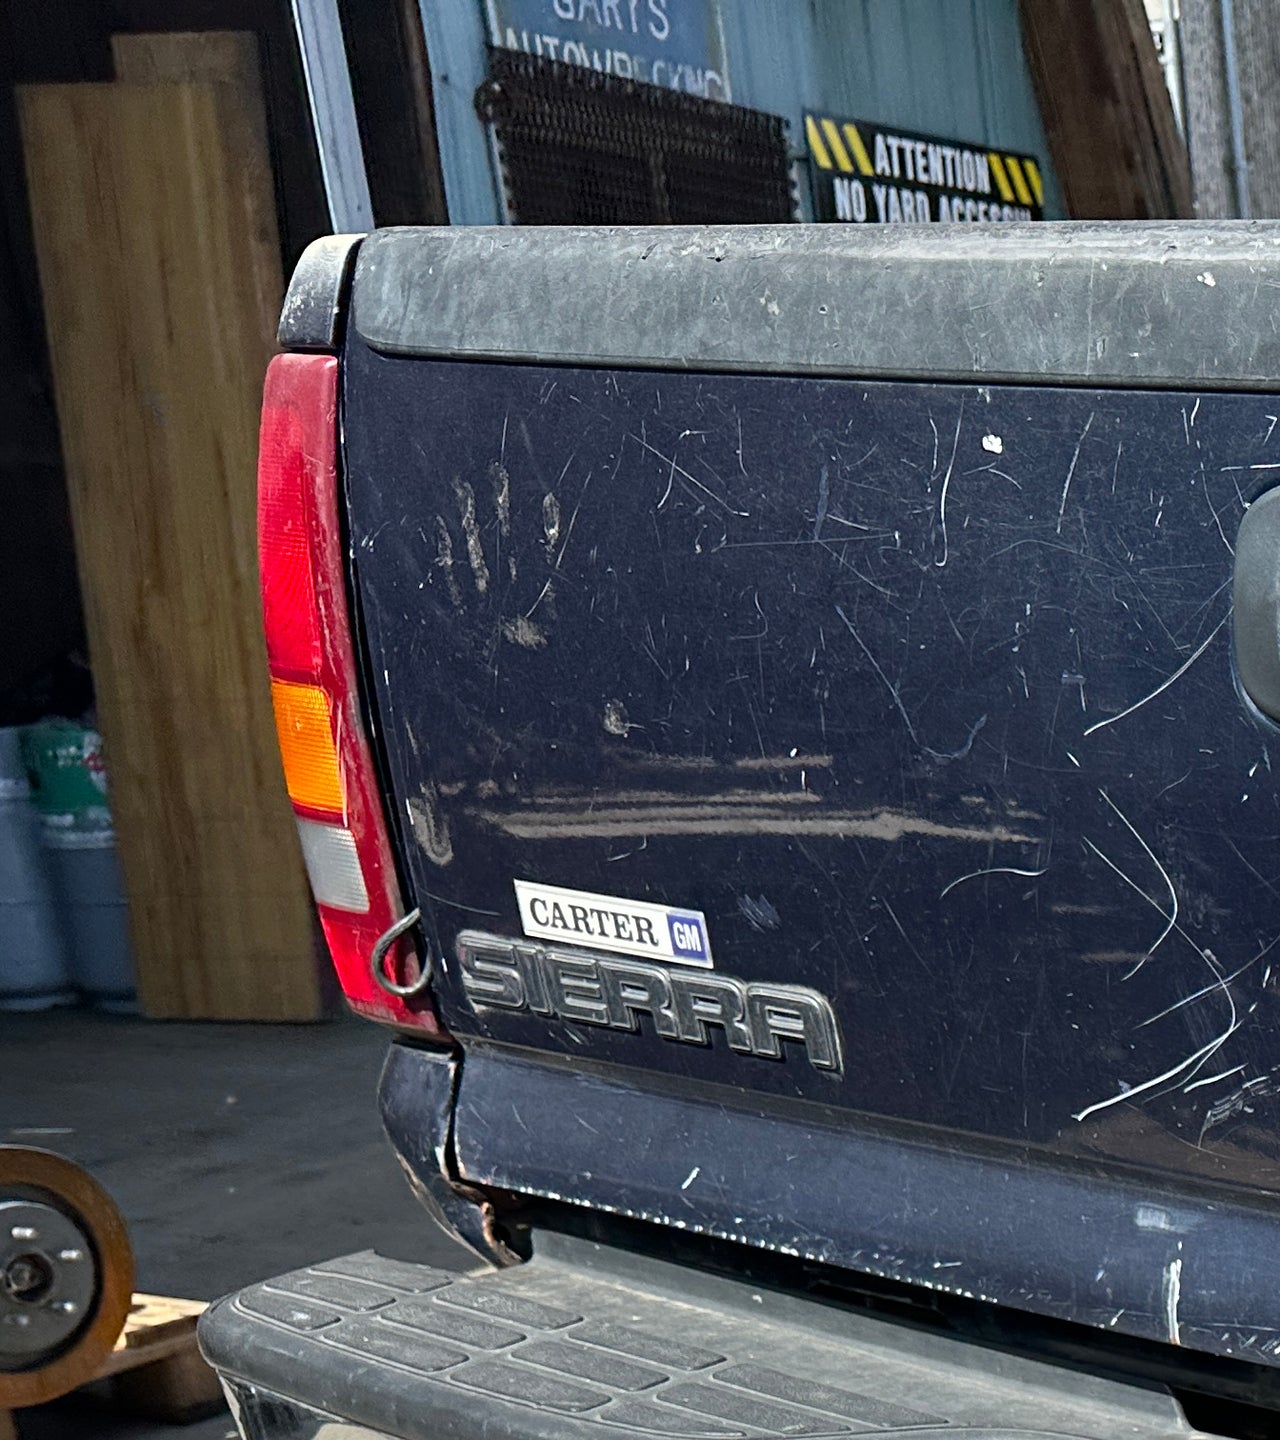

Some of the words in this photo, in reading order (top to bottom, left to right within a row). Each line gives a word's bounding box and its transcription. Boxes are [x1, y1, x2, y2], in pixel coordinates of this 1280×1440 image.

[874, 133, 991, 194] ATTENTION
[833, 177, 867, 221] NO
[872, 183, 931, 222] YARD
[529, 897, 659, 947] CARTER
[672, 920, 702, 952] GM
[456, 929, 845, 1079] SIERRA
